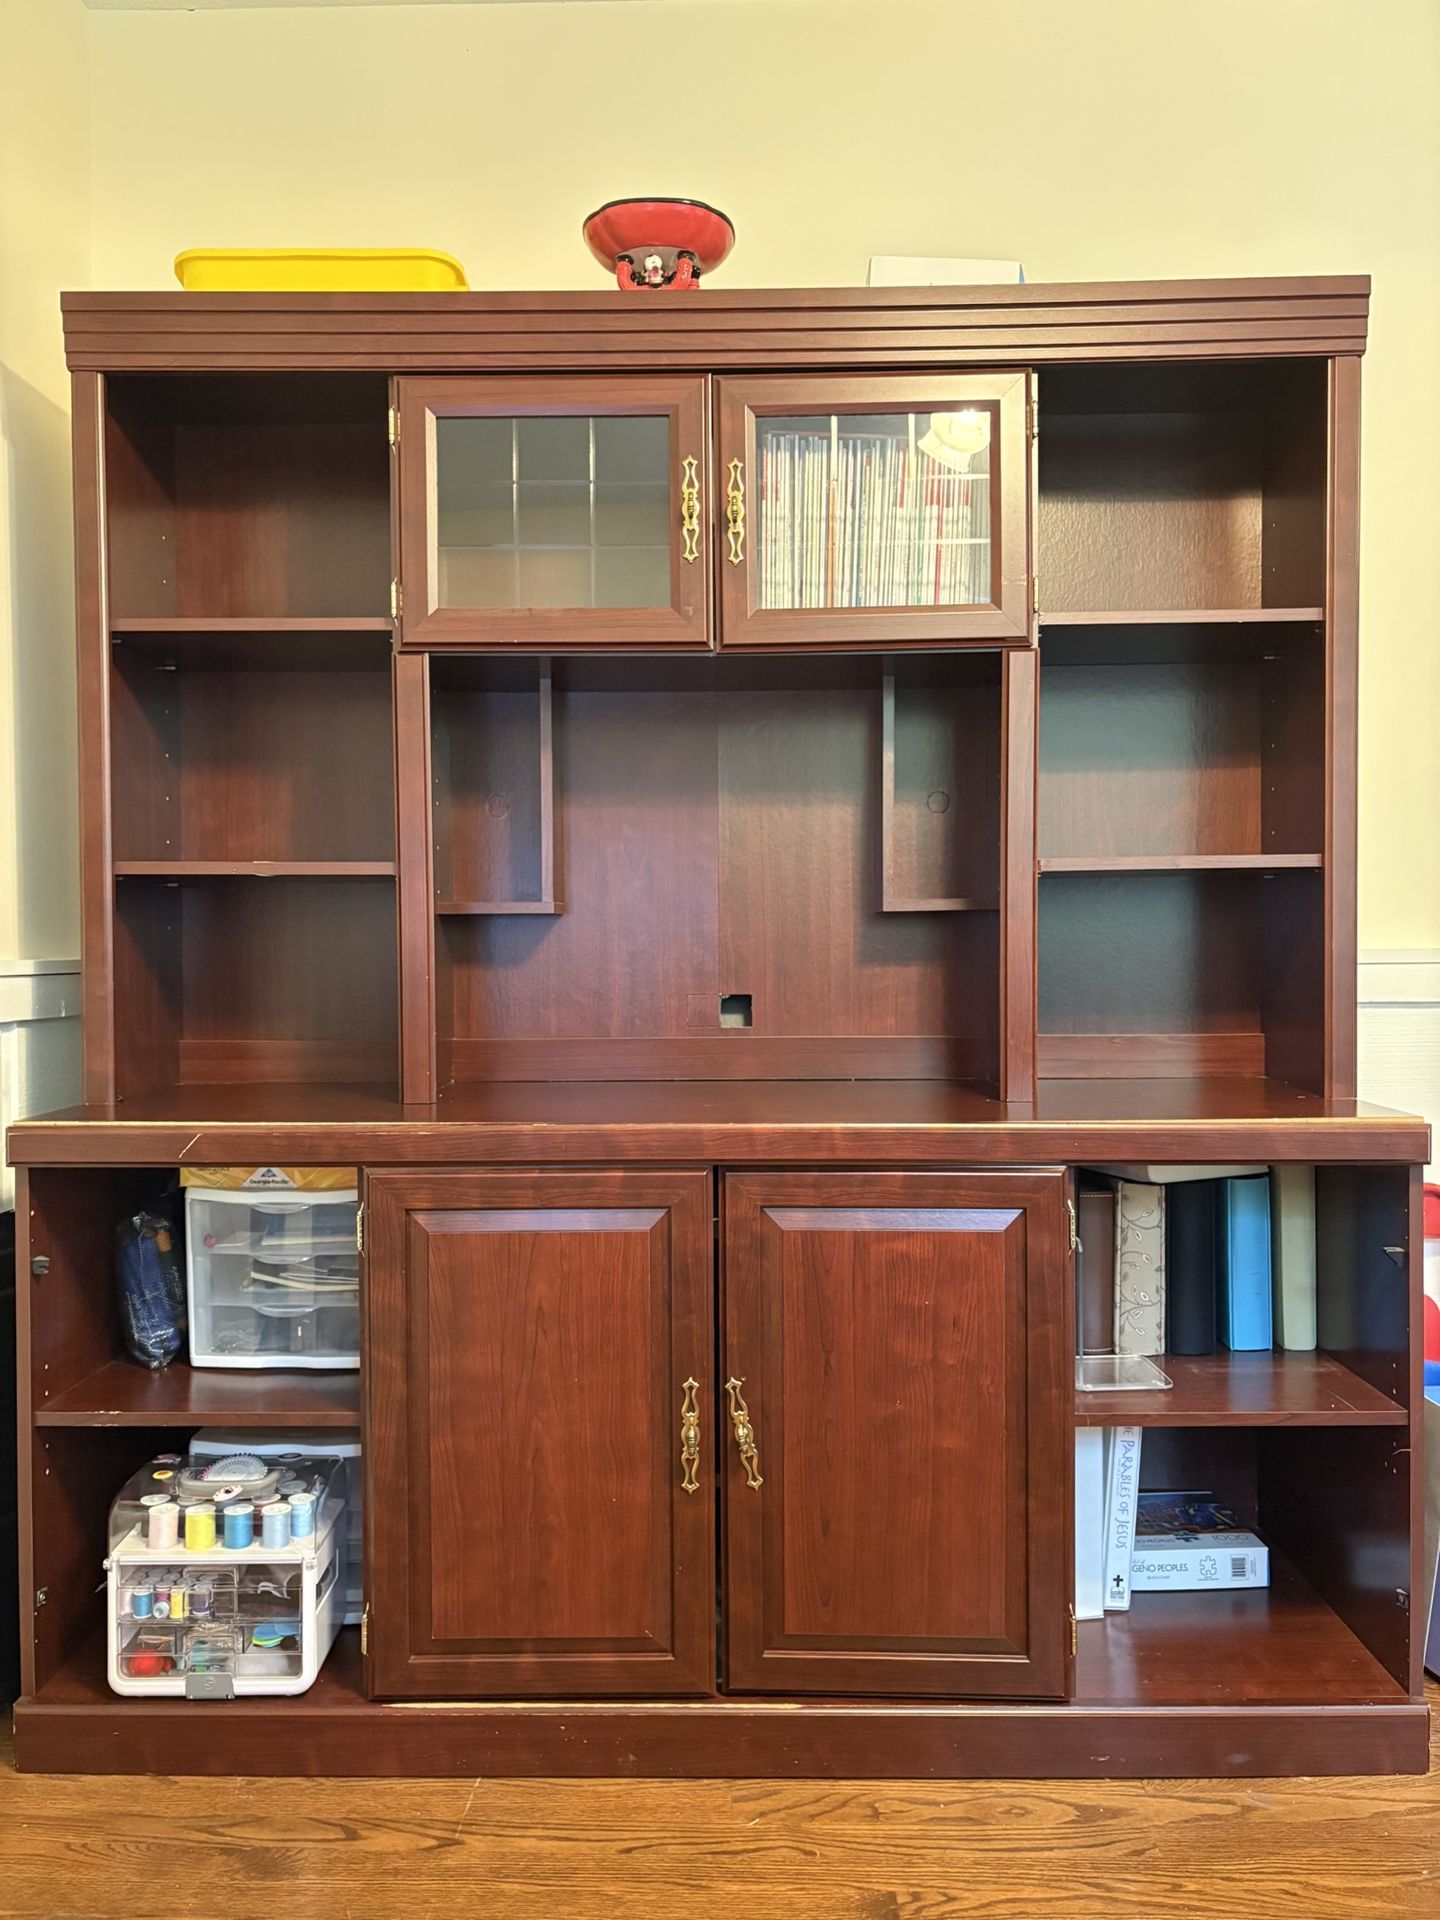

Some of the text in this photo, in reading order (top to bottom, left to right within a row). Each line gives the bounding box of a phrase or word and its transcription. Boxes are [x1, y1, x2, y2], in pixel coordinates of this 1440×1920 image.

[1120, 1440, 1135, 1498] PARABLES
[1119, 1501, 1129, 1515] OF
[1115, 1517, 1130, 1549] JESUS
[1157, 1563, 1189, 1573] PEOPLES
